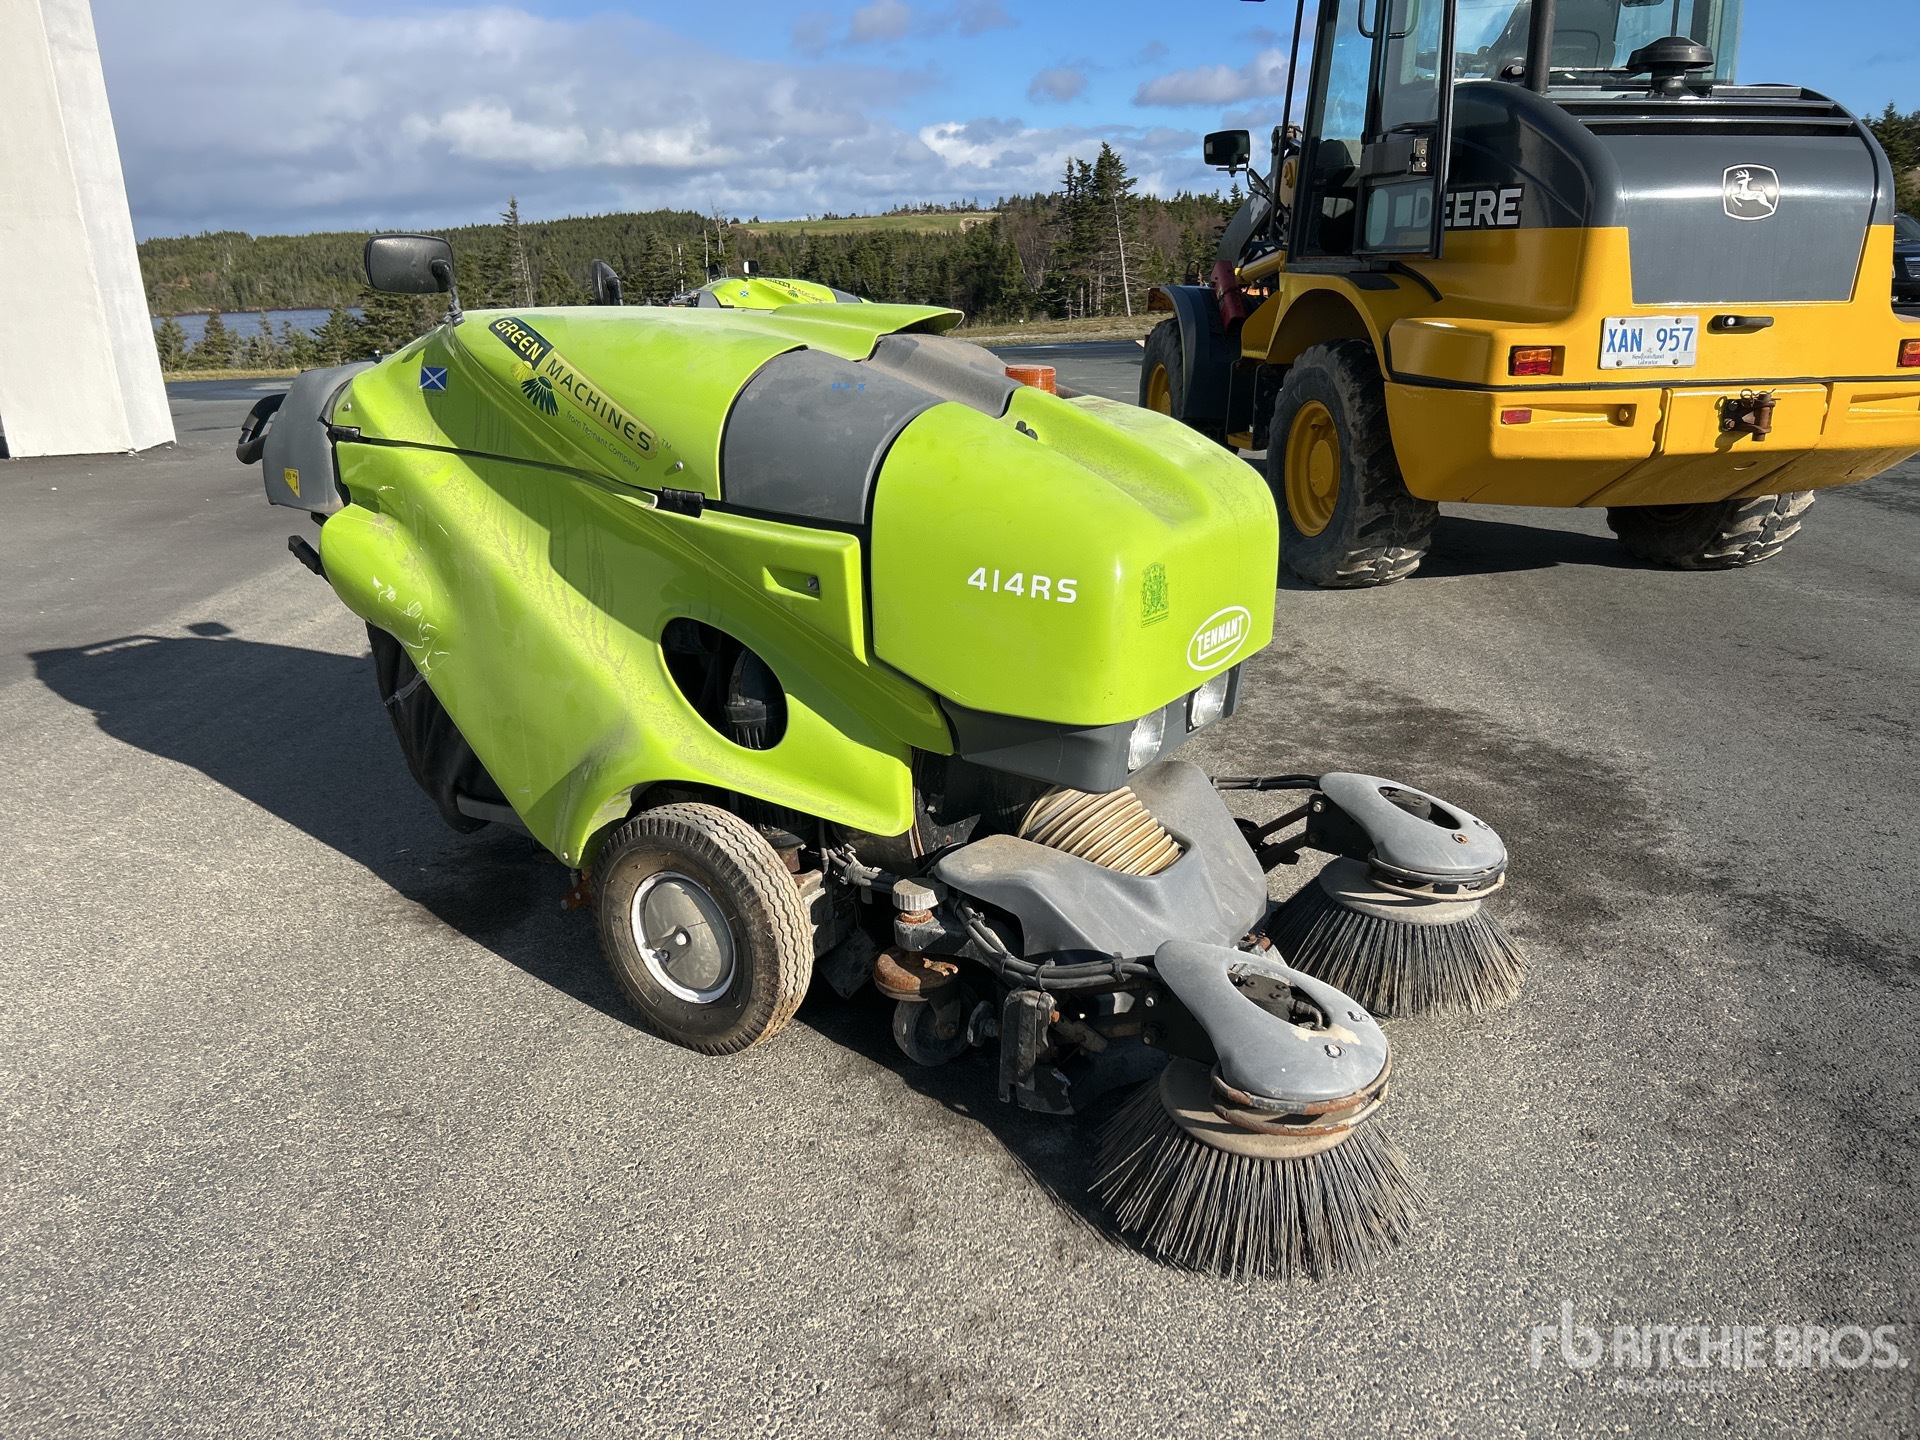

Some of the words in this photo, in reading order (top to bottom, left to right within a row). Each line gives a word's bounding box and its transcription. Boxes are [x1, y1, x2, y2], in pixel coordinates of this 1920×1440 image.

[495, 319, 544, 361] GREEN
[1606, 328, 1643, 353] XAN
[1656, 327, 1694, 352] 957
[545, 358, 652, 452] MACHINES
[566, 411, 582, 428] from
[582, 423, 608, 448] Tennant
[608, 443, 641, 473] Company
[967, 567, 1078, 604] 414RS
[1196, 614, 1245, 661] TENNANT
